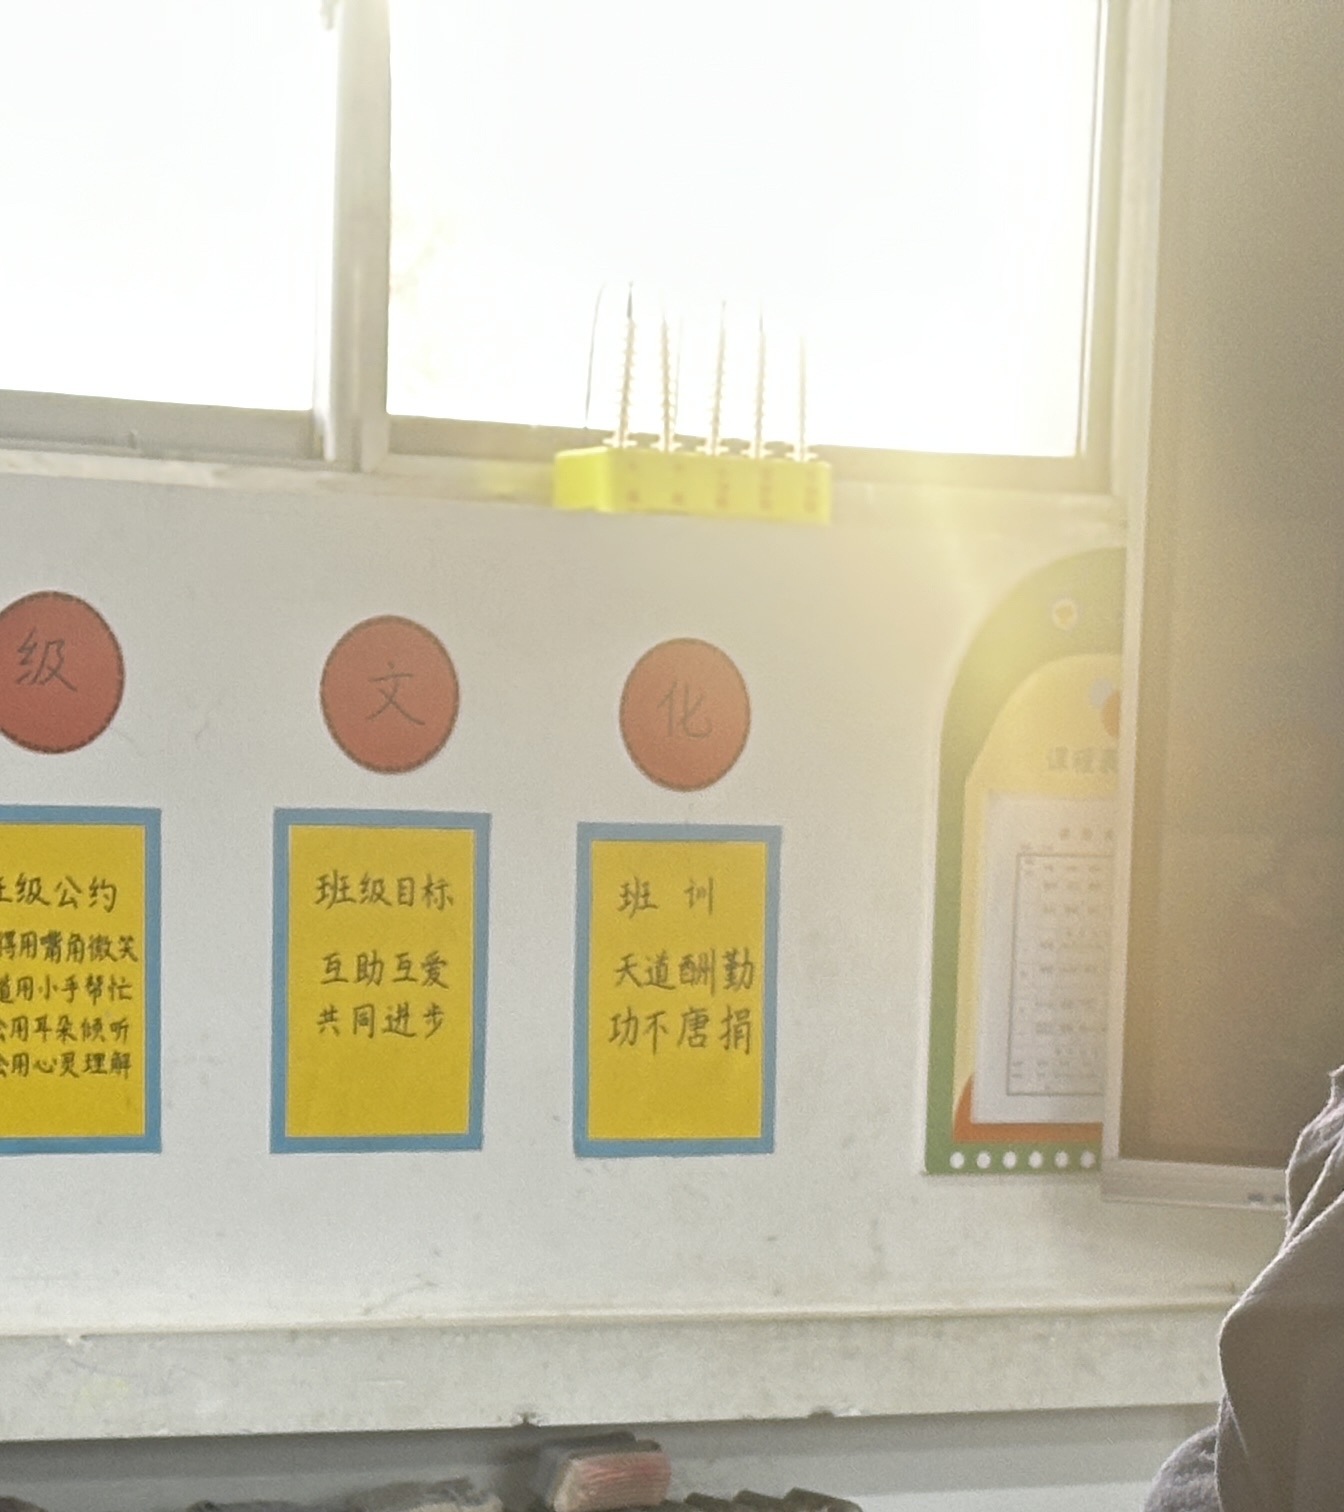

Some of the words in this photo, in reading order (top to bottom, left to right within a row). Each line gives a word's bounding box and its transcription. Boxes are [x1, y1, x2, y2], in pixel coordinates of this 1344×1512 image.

[15, 624, 78, 693] 级
[366, 660, 426, 726] 文
[656, 678, 714, 738] 化
[314, 869, 455, 911] 班级目标
[320, 949, 450, 990] 互助互爱
[614, 947, 755, 997] 天道酬勤
[316, 1001, 445, 1039] 共同进步
[607, 1004, 752, 1056] 功不唐捐
